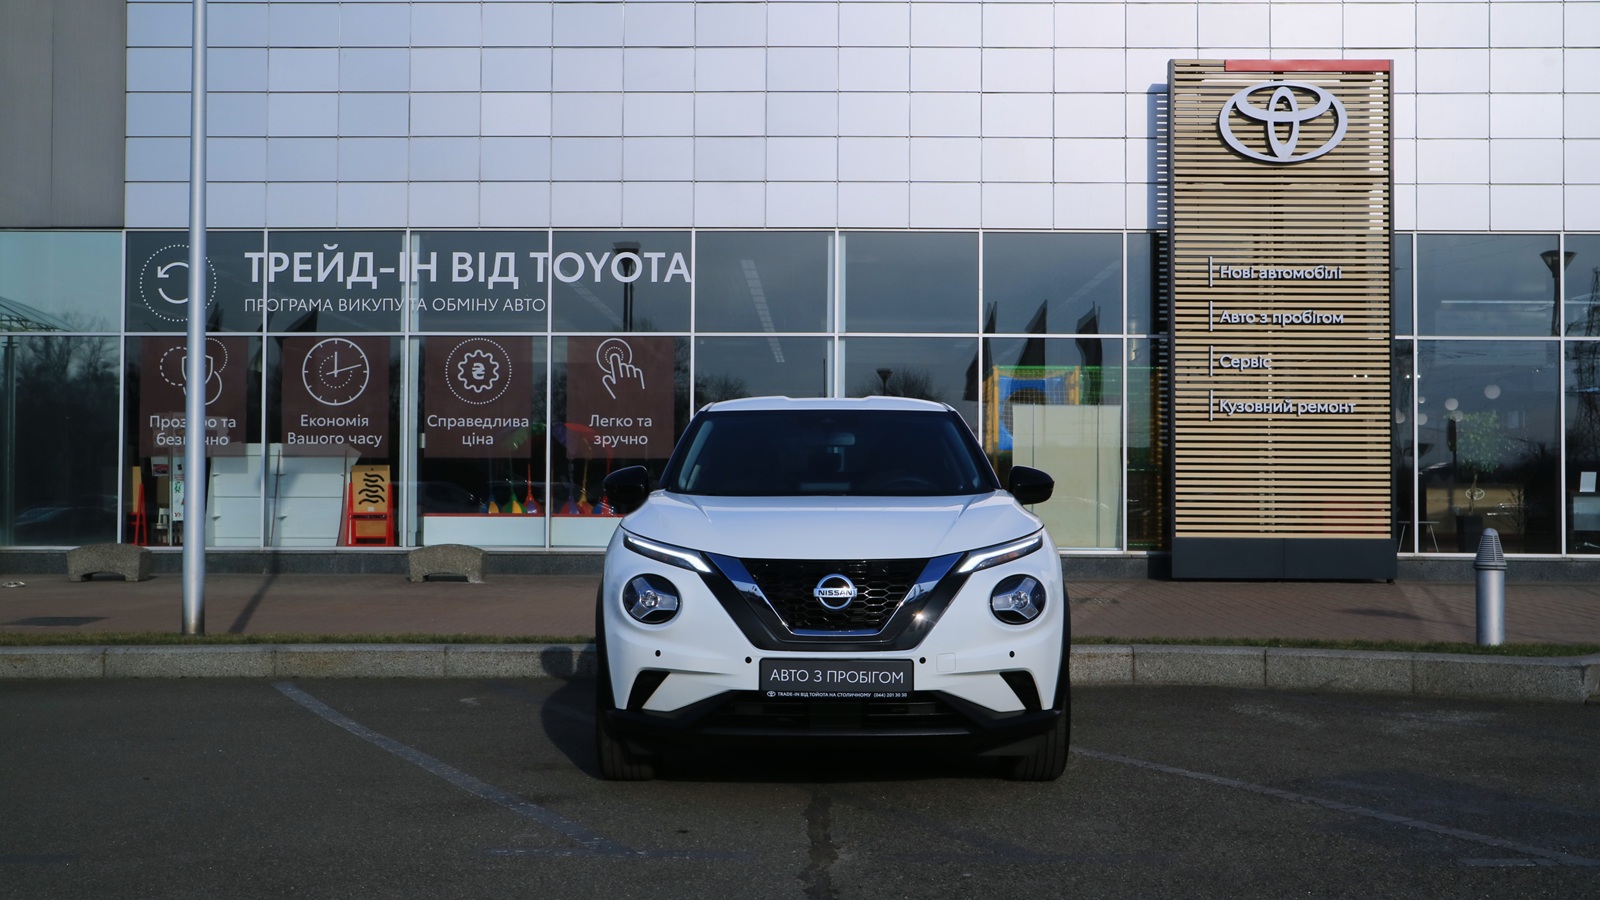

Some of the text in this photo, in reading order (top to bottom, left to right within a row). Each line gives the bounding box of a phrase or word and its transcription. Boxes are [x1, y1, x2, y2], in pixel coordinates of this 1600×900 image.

[244, 244, 692, 290] ТРЕЙД-ІН ВІД TOYOTA
[1219, 265, 1342, 279] Нові автомобілі
[244, 297, 546, 312] ПРОГРАМА ВИКУПУ ТА ОБМІНУ АВТО
[1219, 310, 1344, 327] Авто з пробігом
[1219, 355, 1272, 371] Сервіс
[1219, 399, 1356, 416] Кузовний ремонт
[149, 415, 236, 430] Прозо та
[300, 414, 369, 427] Економія
[427, 415, 529, 428] Справедлива
[589, 415, 652, 427] Легко та
[156, 432, 229, 445] безно
[287, 432, 382, 447] Вашого часу
[462, 433, 494, 446] ціна
[594, 434, 648, 448] зручно
[770, 669, 904, 684] АВТО З ПРОБІГОМ
